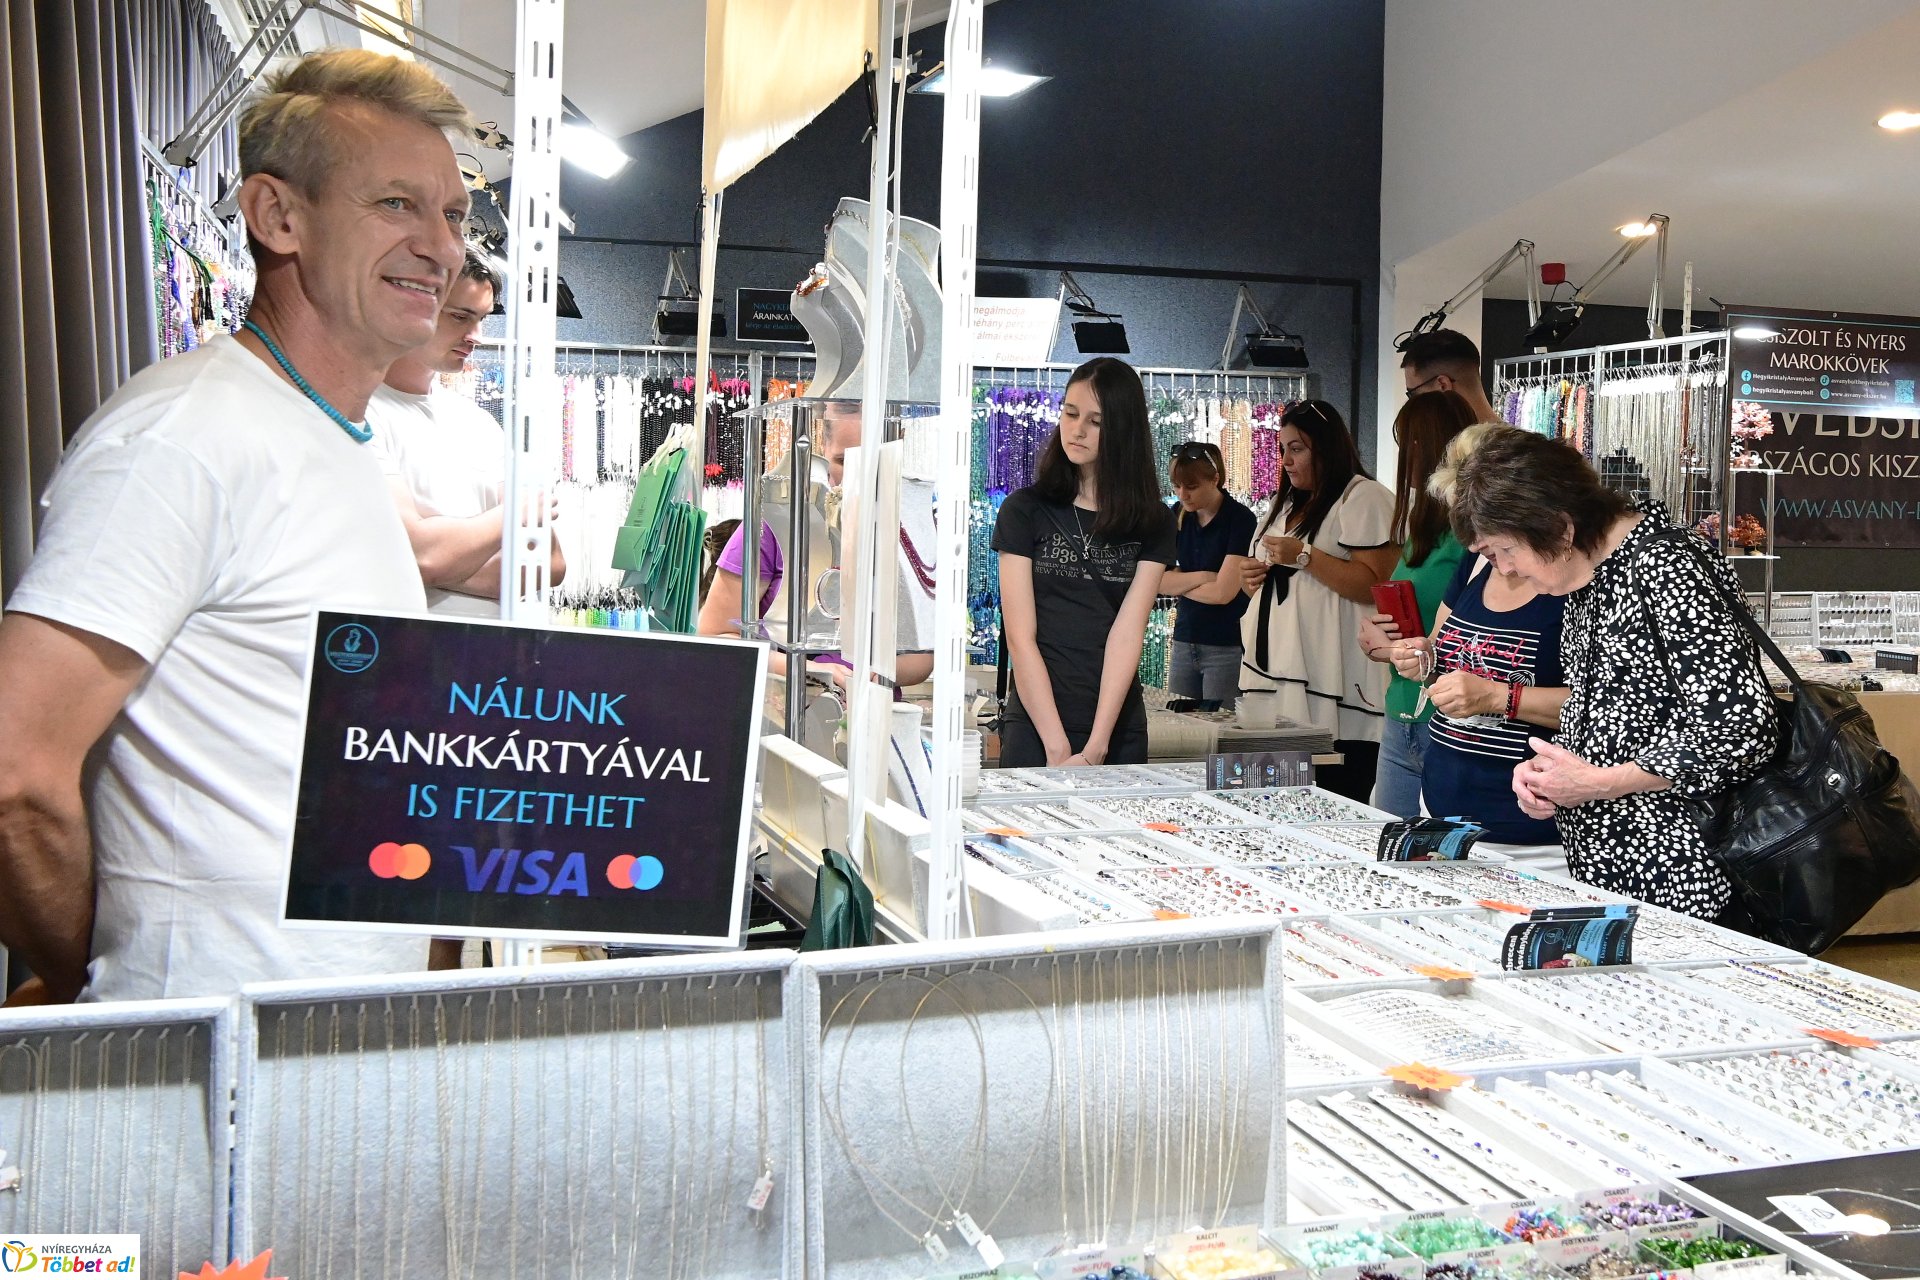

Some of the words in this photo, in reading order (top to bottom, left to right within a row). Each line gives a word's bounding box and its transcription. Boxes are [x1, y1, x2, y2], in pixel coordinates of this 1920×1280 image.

[752, 310, 794, 321] ÁRAINKAT
[1836, 327, 1851, 348] ÉS
[1857, 333, 1906, 352] NYERS
[1769, 352, 1891, 374] MAROKKÖVEK
[1041, 547, 1078, 564] 1938
[1035, 565, 1053, 575] NEW
[1056, 569, 1080, 578] YORK
[448, 676, 627, 726] NÁLUNK
[343, 727, 711, 783] BANKKÁRTYÁVAL
[407, 783, 437, 818] IS
[454, 787, 646, 829] FIZETHET
[448, 844, 590, 897] VISA
[1196, 1231, 1219, 1241] KALCIT
[1303, 1224, 1339, 1233] AMAZONIT
